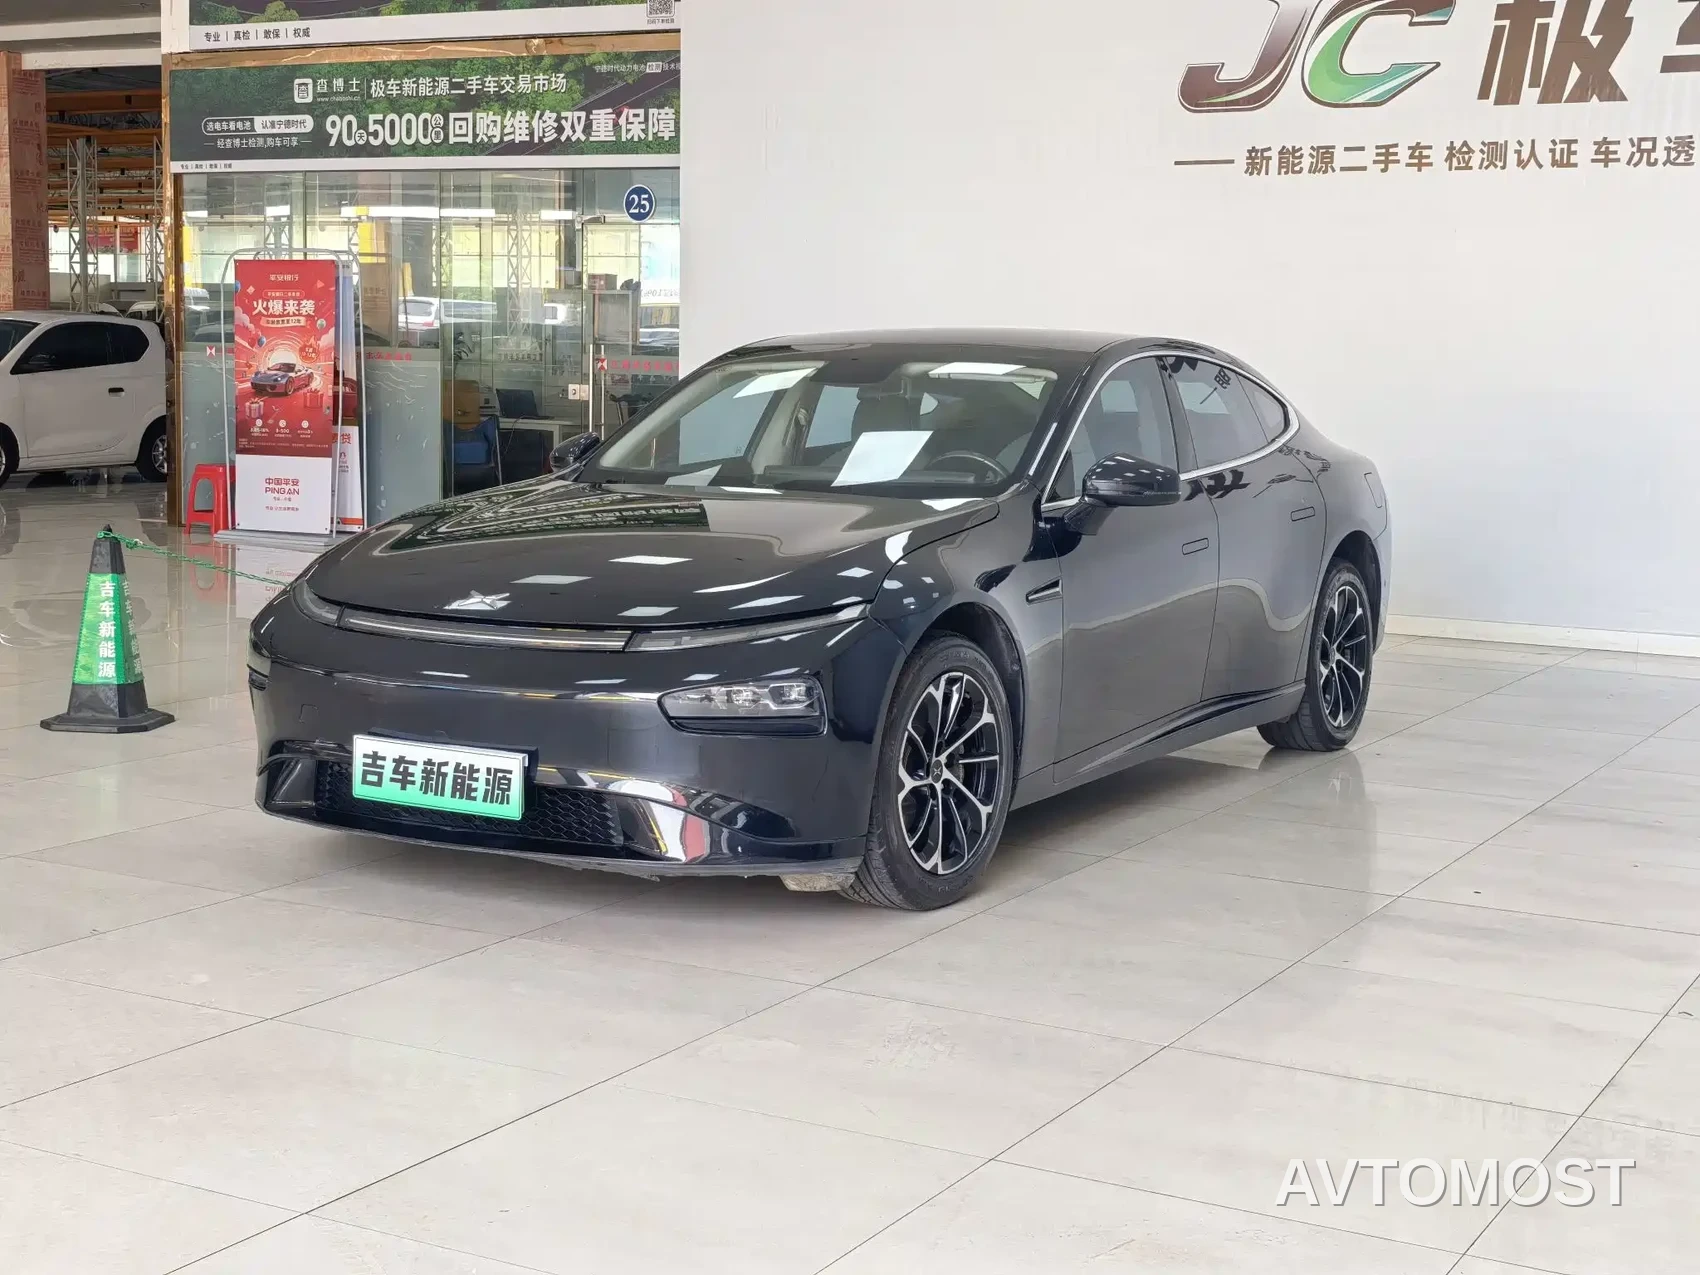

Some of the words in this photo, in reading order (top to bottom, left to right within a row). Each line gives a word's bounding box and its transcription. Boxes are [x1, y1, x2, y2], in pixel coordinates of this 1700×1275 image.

[203, 31, 221, 42] 专业
[233, 29, 251, 41] 真检
[263, 28, 281, 40] 敢保
[293, 27, 311, 39] 权威
[370, 73, 567, 97] 极车新能源二手车交易市场
[206, 120, 251, 132] 选电车看电池
[260, 118, 308, 131] 认准宁德时代
[1445, 139, 1580, 173] 检测认证
[1591, 135, 1696, 169] 车况透
[628, 194, 650, 214] 25
[252, 299, 316, 316] 火爆来袭
[264, 477, 300, 487] 中国平安
[97, 581, 116, 678] 吉车新能源
[360, 750, 513, 806] 吉车新能源
